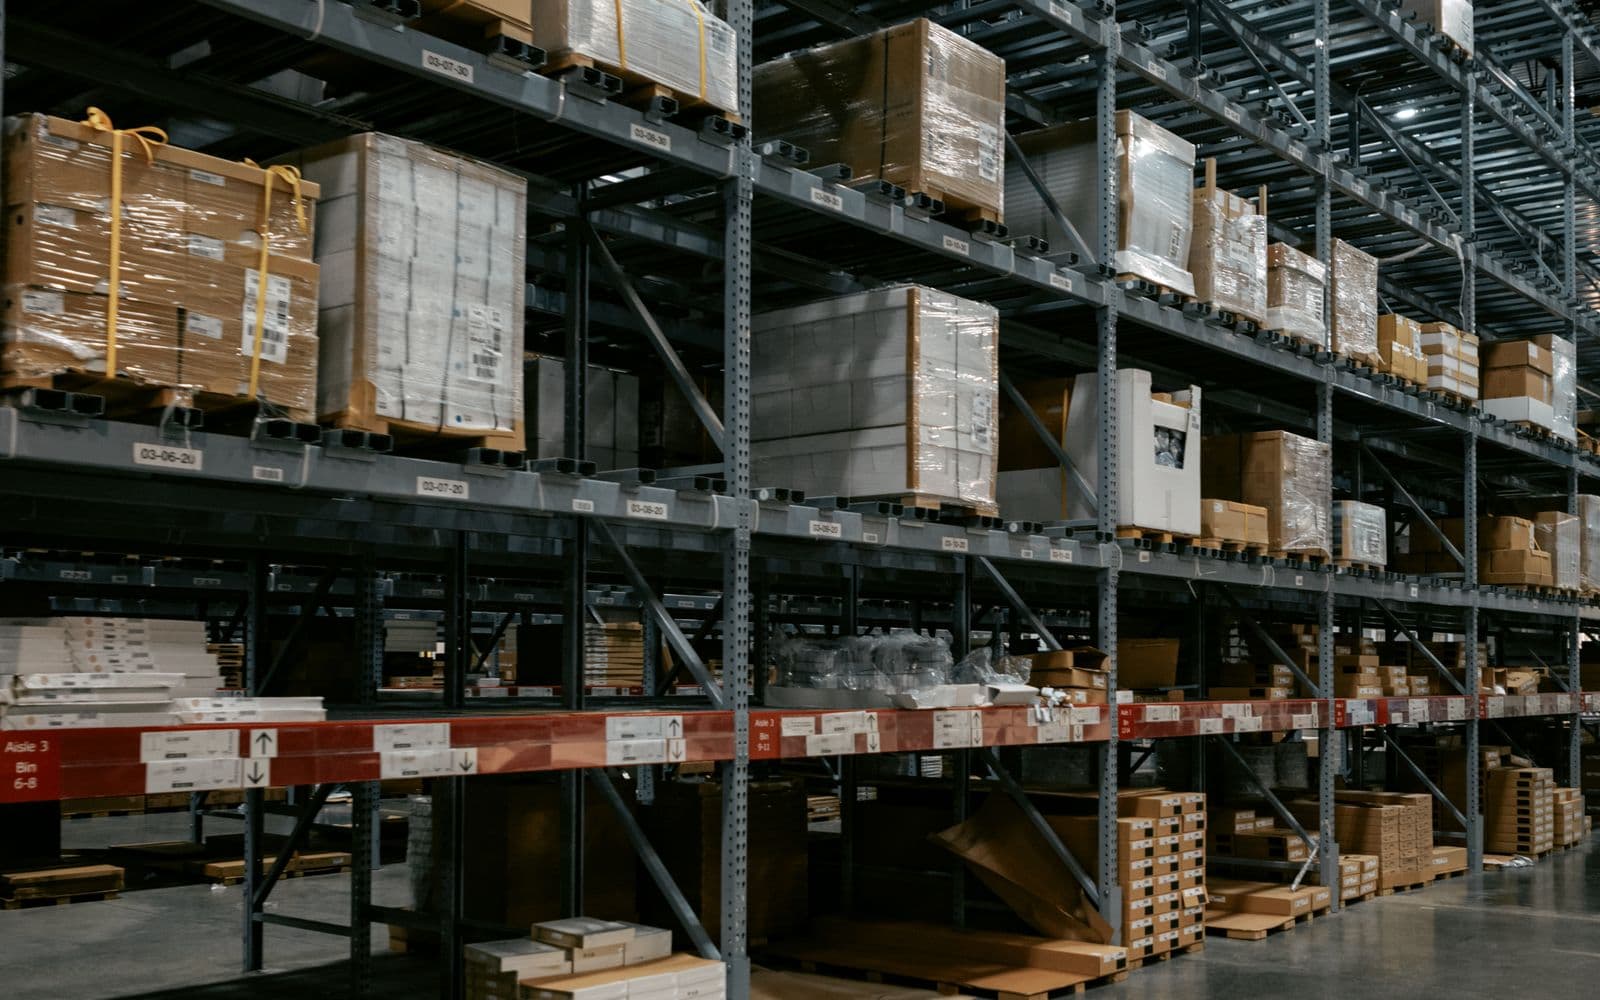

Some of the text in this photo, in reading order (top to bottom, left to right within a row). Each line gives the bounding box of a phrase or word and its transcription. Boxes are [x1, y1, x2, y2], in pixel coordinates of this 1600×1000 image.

[427, 54, 470, 77] 03-07-30
[141, 448, 196, 465] 03-06-20
[423, 481, 464, 495] 03-07-20
[4, 740, 49, 753] Aisle 3
[15, 762, 38, 774] Bin
[13, 777, 38, 790] 6-8
